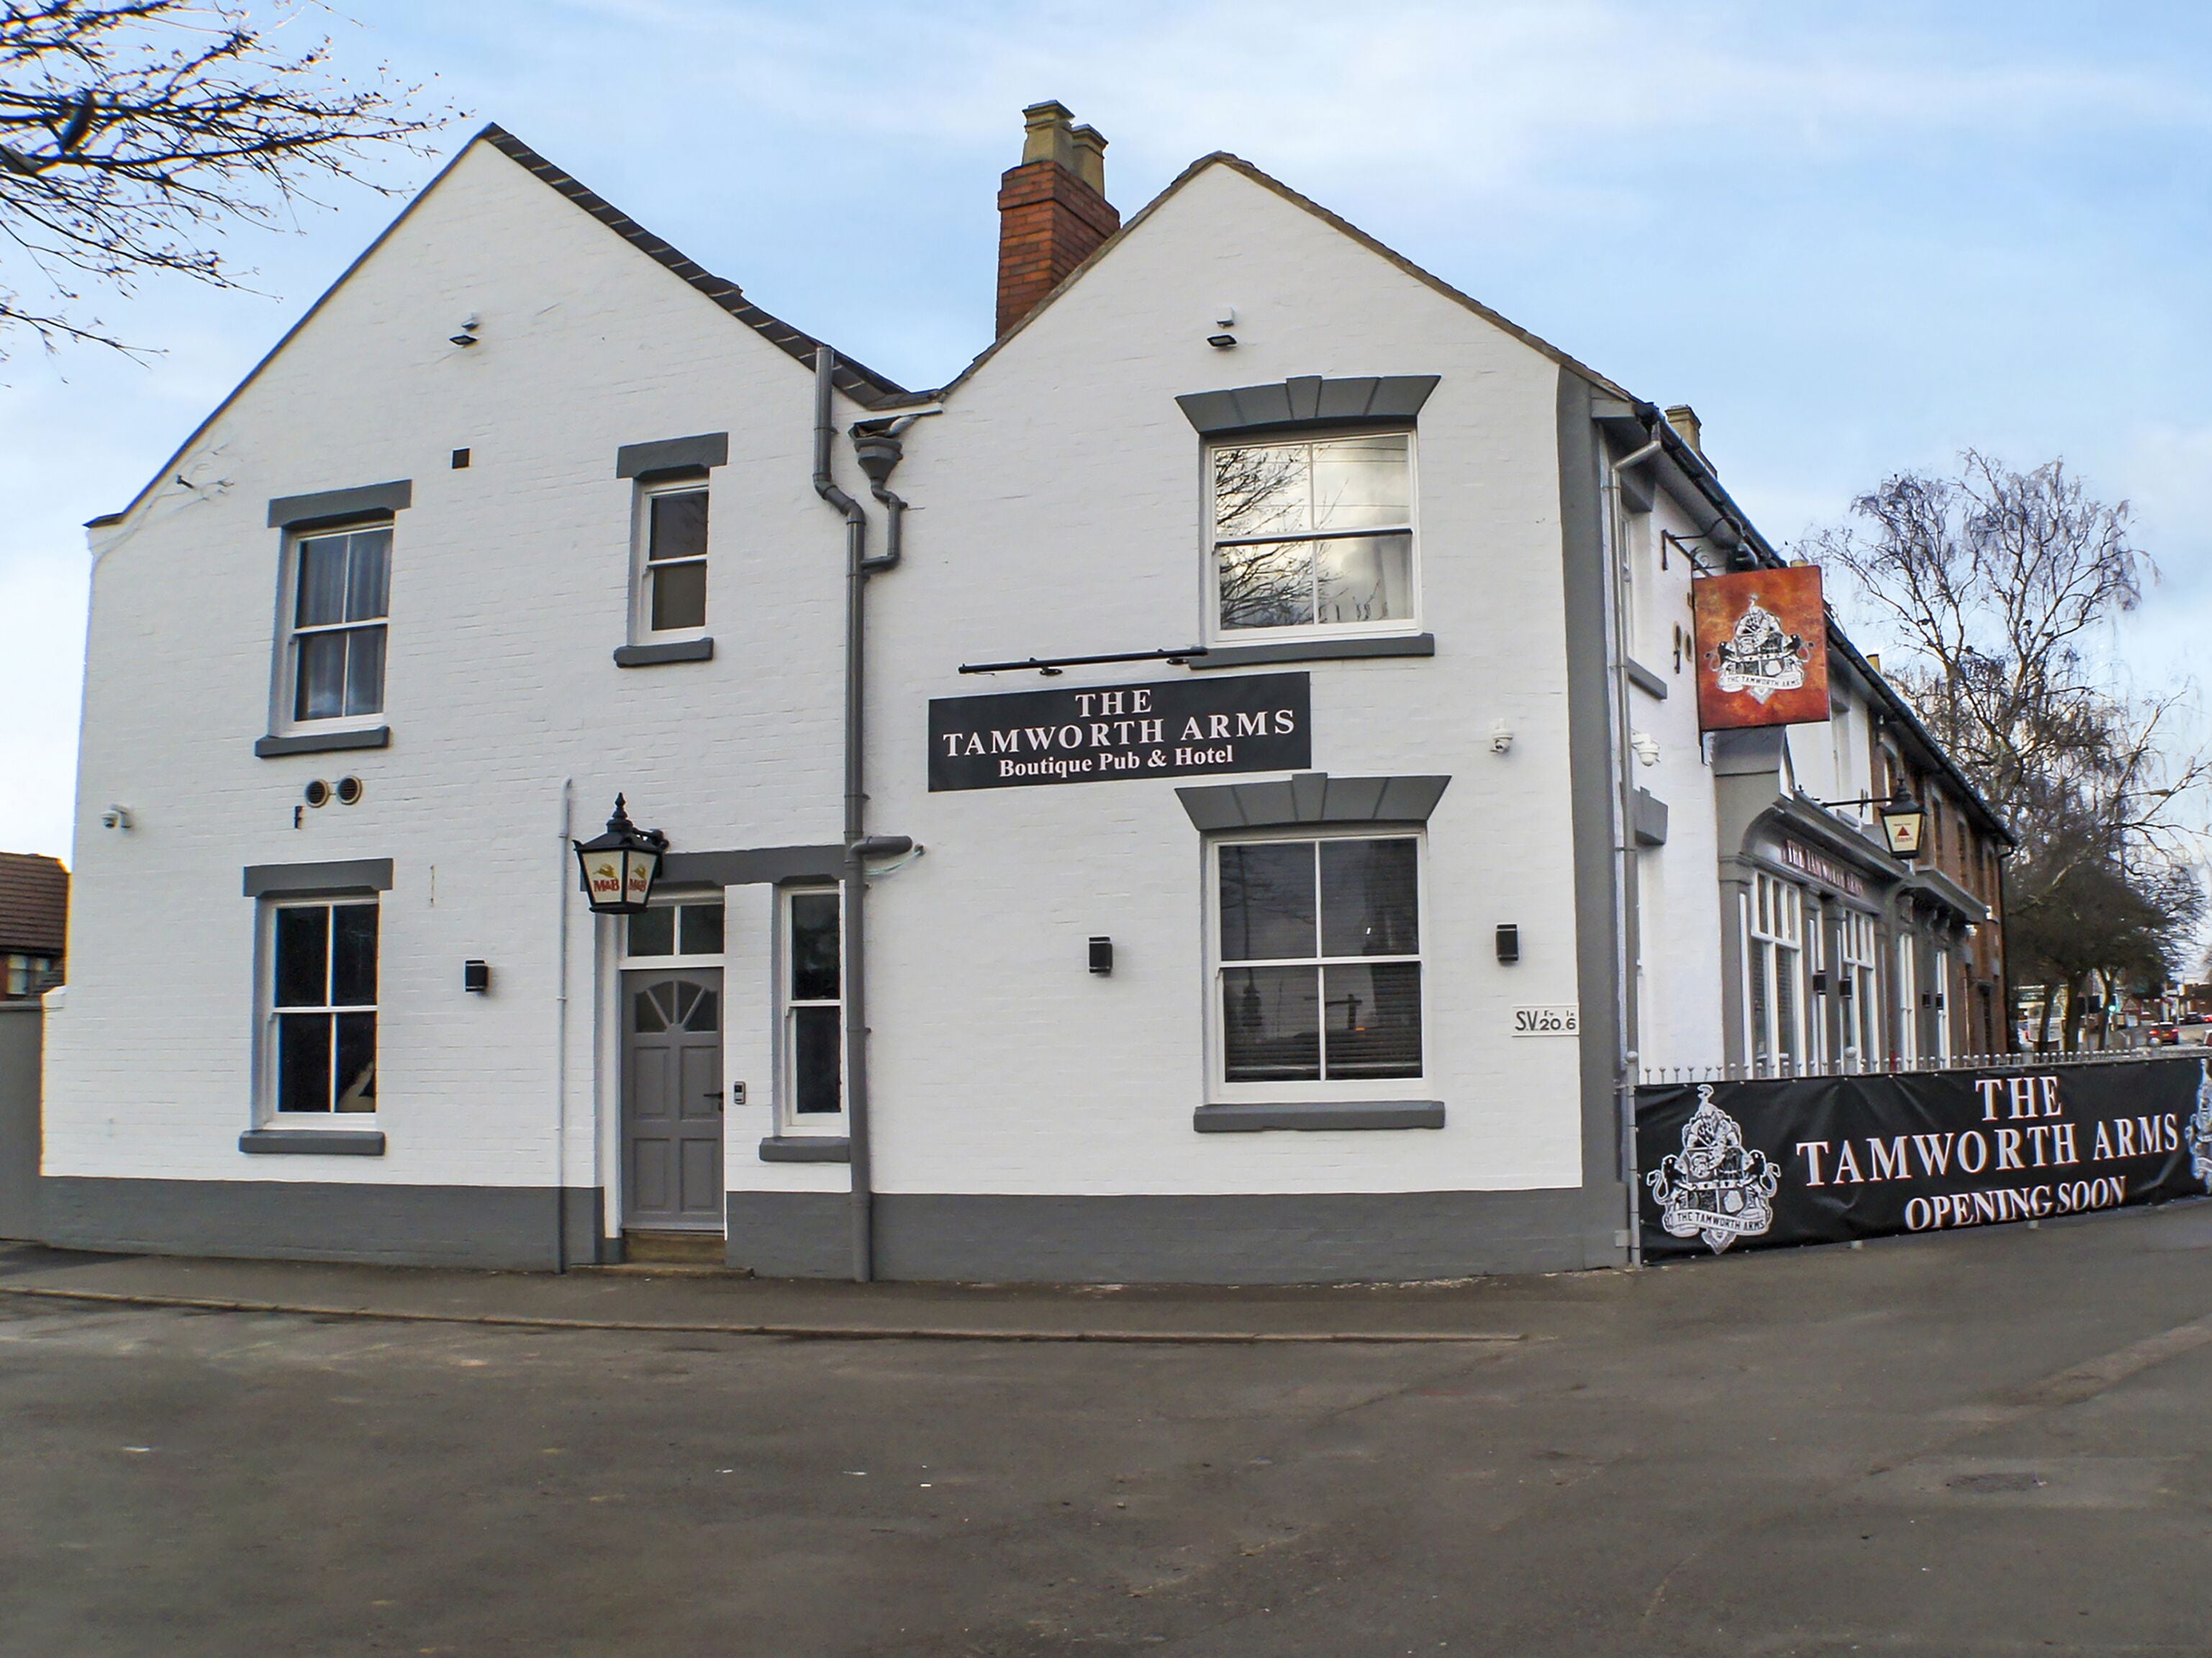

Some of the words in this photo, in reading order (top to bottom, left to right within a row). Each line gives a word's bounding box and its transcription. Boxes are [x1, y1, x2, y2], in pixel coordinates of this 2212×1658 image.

[1075, 689, 1152, 717] THE
[943, 718, 1164, 757] TAMWORTH
[1181, 710, 1295, 740] ARMS
[1000, 757, 1092, 778] Boutique
[1100, 751, 1141, 771] Pub
[1147, 749, 1167, 768] &
[1175, 746, 1233, 765] Hotel
[593, 879, 620, 892] M&B
[1975, 1077, 2062, 1121] THE
[1796, 1123, 2080, 1187] TAMWORTH
[2093, 1113, 2179, 1161] ARMS
[1677, 1212, 1693, 1222] THE
[1695, 1212, 1741, 1229] TAMWORTH
[1743, 1219, 1765, 1231] ARMS
[1905, 1185, 2053, 1231] OPENING
[2057, 1176, 2127, 1214] SOON
